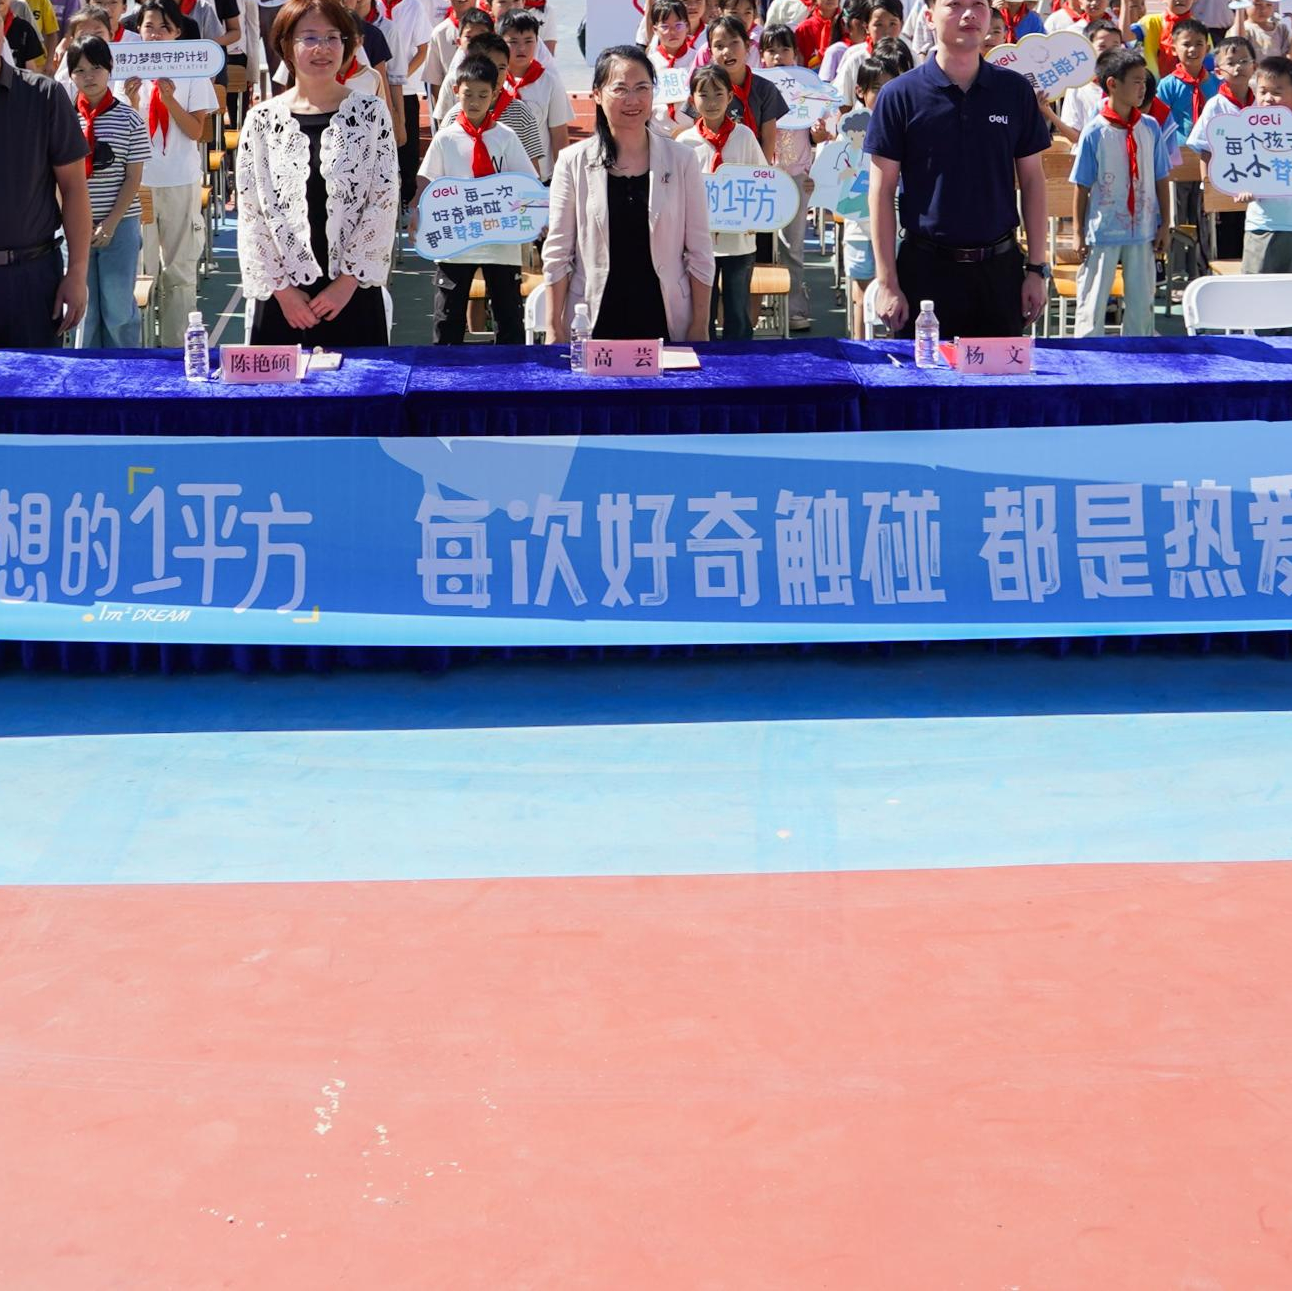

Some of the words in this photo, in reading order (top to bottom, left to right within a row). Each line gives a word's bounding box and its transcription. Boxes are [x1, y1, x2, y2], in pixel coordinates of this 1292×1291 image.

[115, 51, 208, 65] 得力梦想守护计划
[989, 115, 1008, 124] deli
[1249, 114, 1281, 126] deli
[753, 170, 775, 179] deli
[432, 185, 458, 198] deli
[464, 185, 513, 202] 每一次
[432, 200, 502, 224] 好奇触碰
[425, 216, 535, 249] 都是梦想的起点
[230, 353, 292, 374] 陈艳硕
[416, 489, 946, 608] 每次好奇触碰
[131, 607, 192, 623] DREAM
